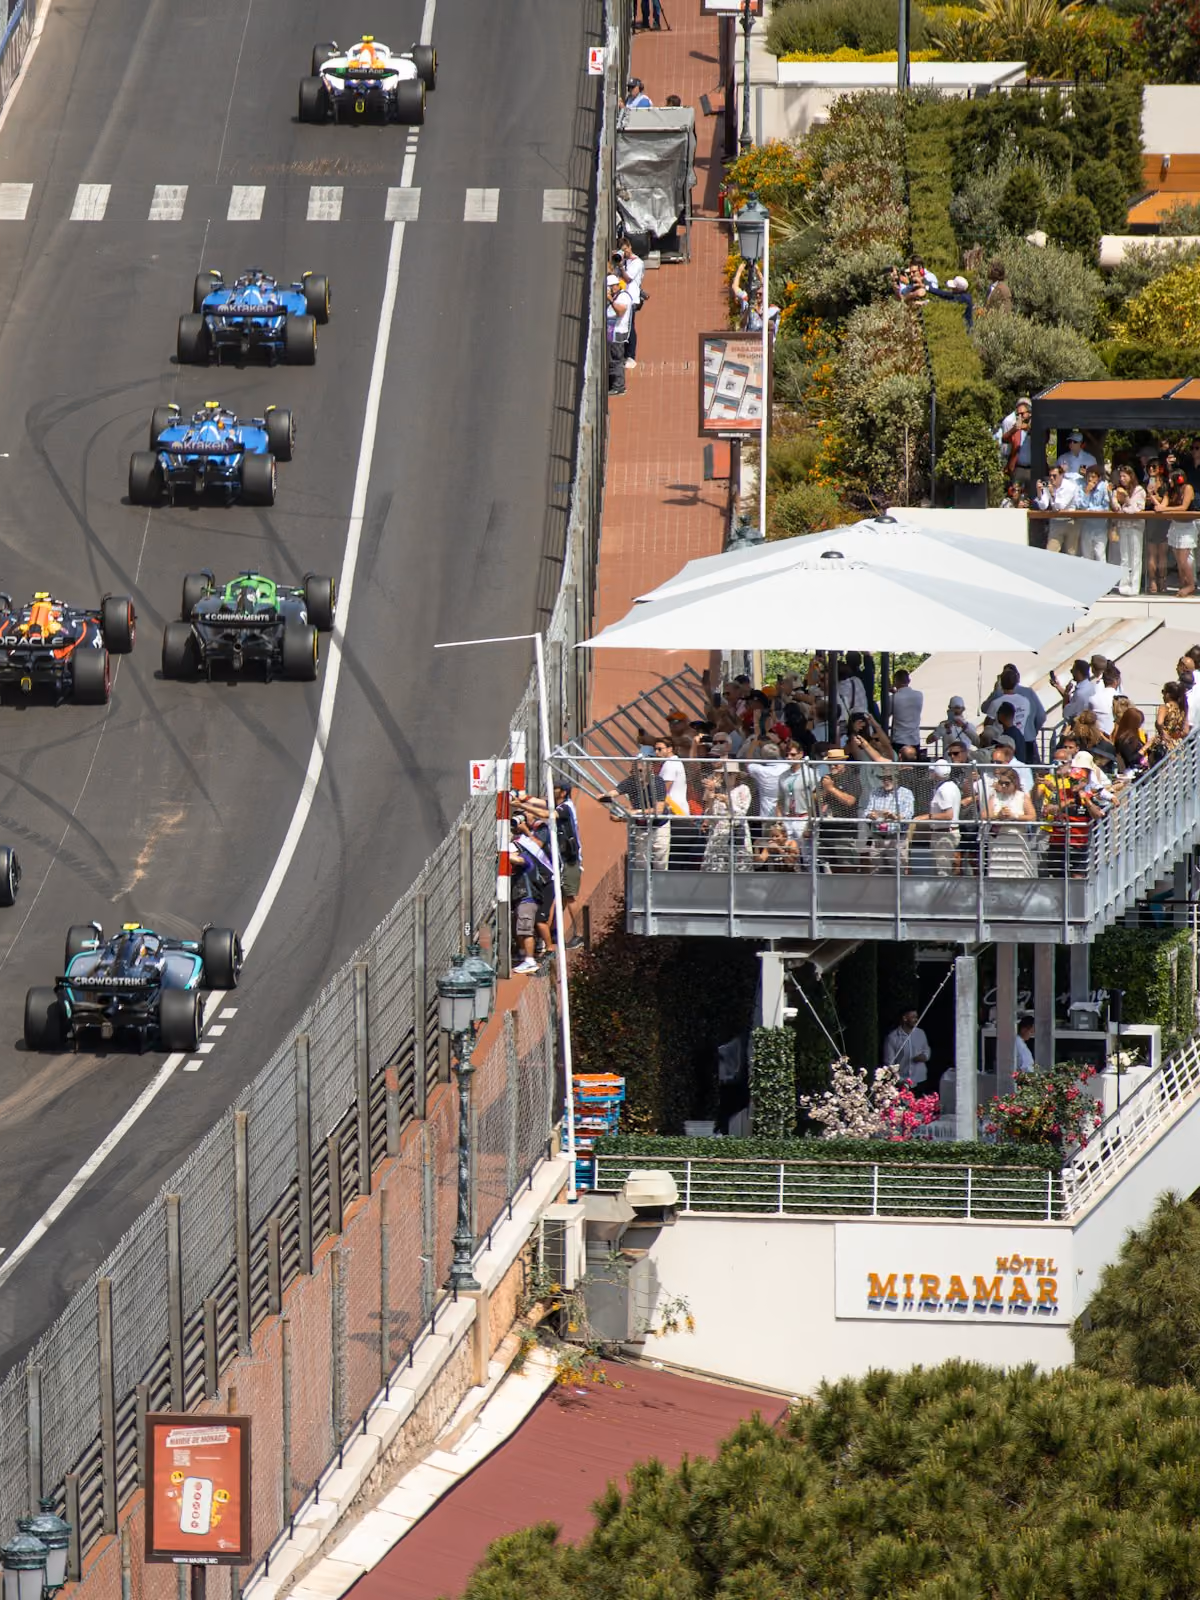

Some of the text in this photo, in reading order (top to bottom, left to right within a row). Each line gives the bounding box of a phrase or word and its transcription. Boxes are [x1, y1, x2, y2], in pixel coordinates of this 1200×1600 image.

[74, 976, 147, 986] CROWDSTRIKE
[995, 1254, 1058, 1273] HÔTEL
[867, 1272, 1059, 1303] MIRAMAR
